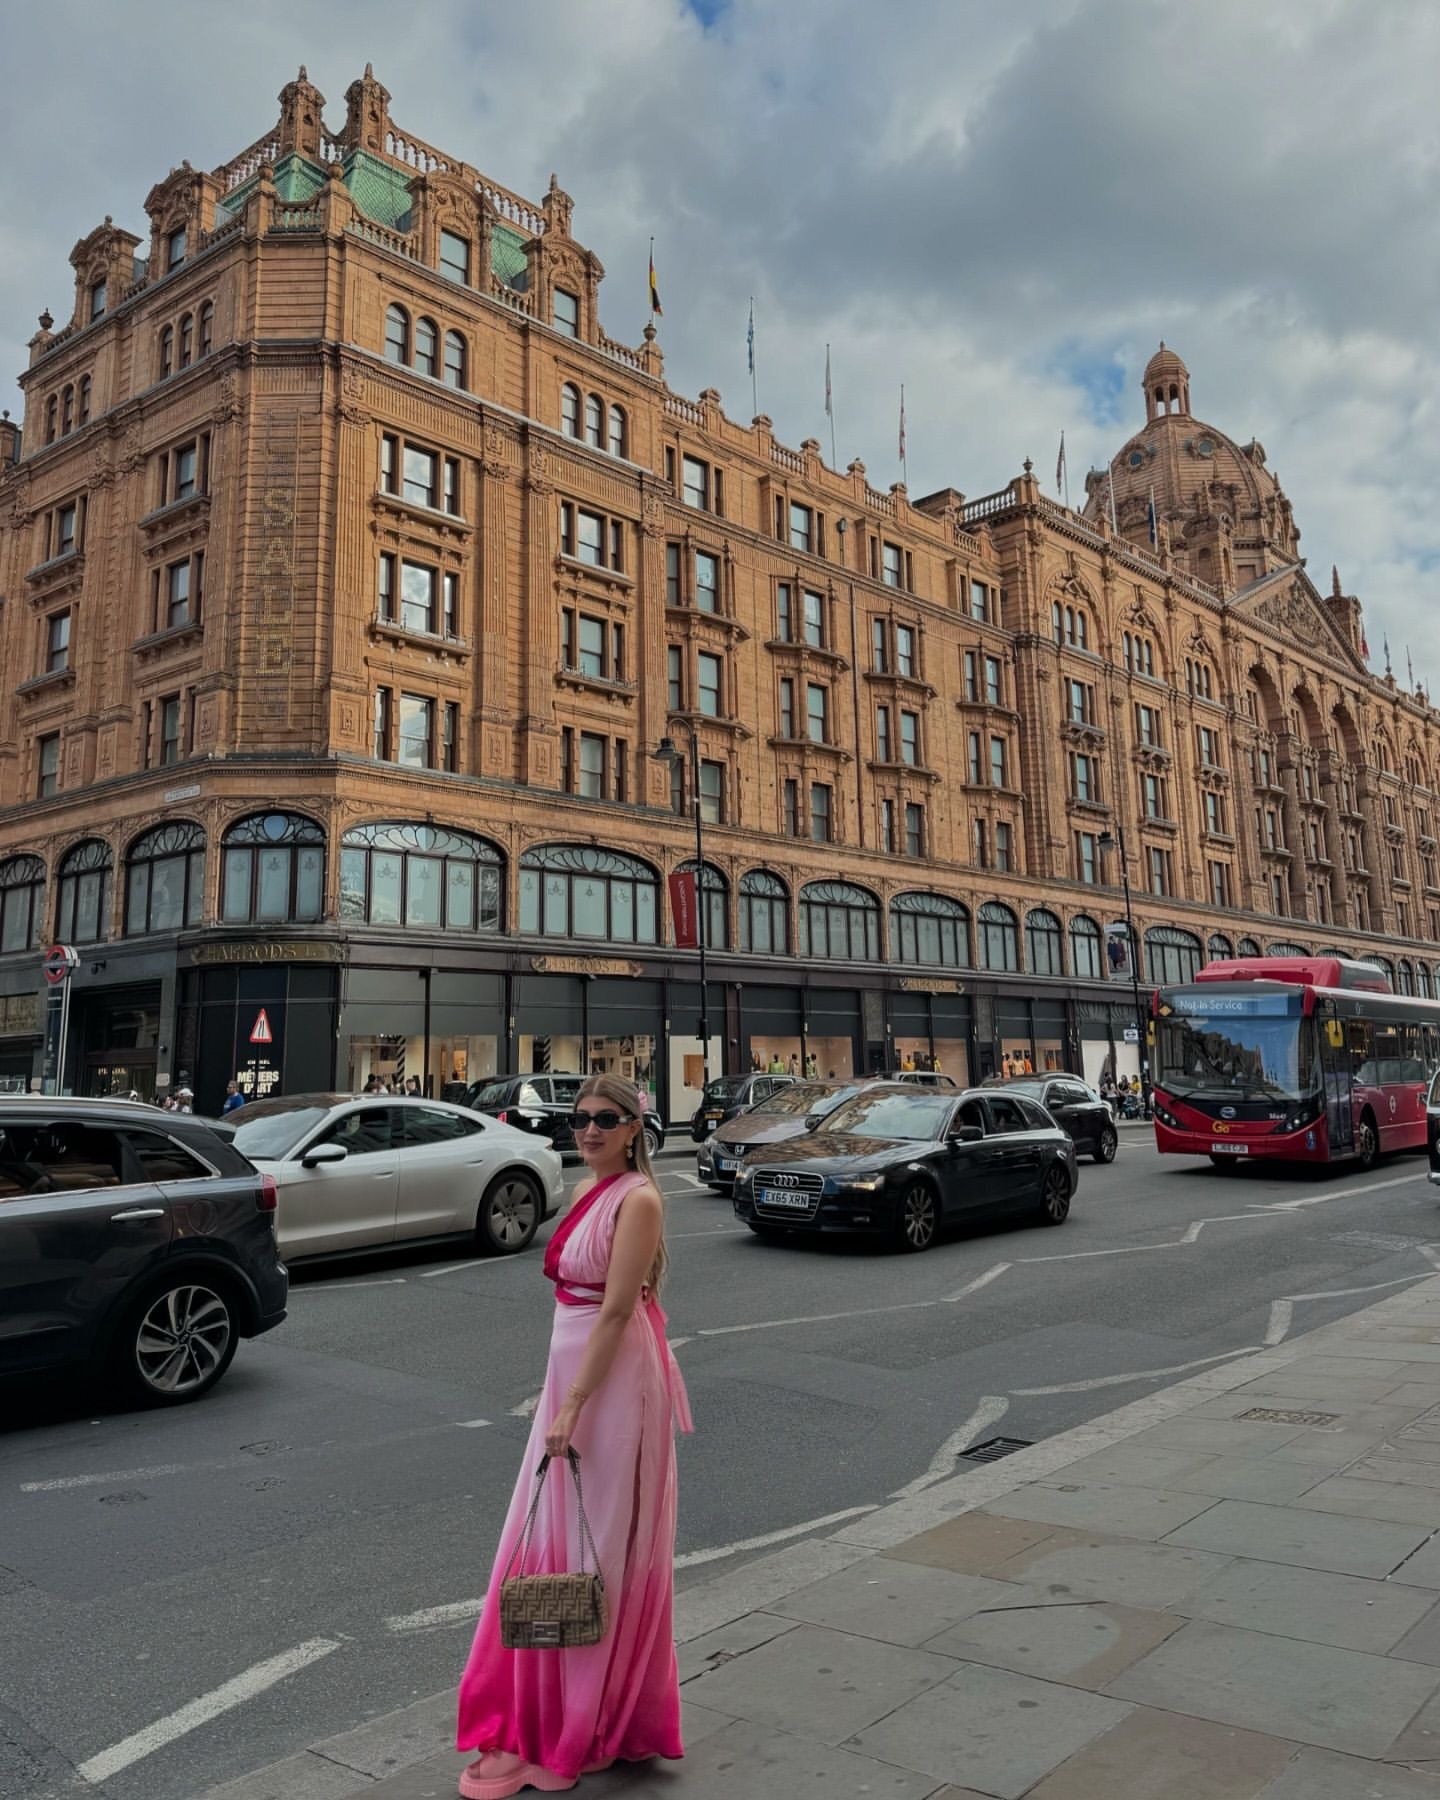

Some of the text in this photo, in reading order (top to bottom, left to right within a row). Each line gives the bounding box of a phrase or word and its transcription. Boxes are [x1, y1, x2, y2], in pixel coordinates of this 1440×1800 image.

[207, 943, 297, 961] HARRODS
[1210, 1000, 1243, 1010] Service
[1212, 1120, 1230, 1134] Go
